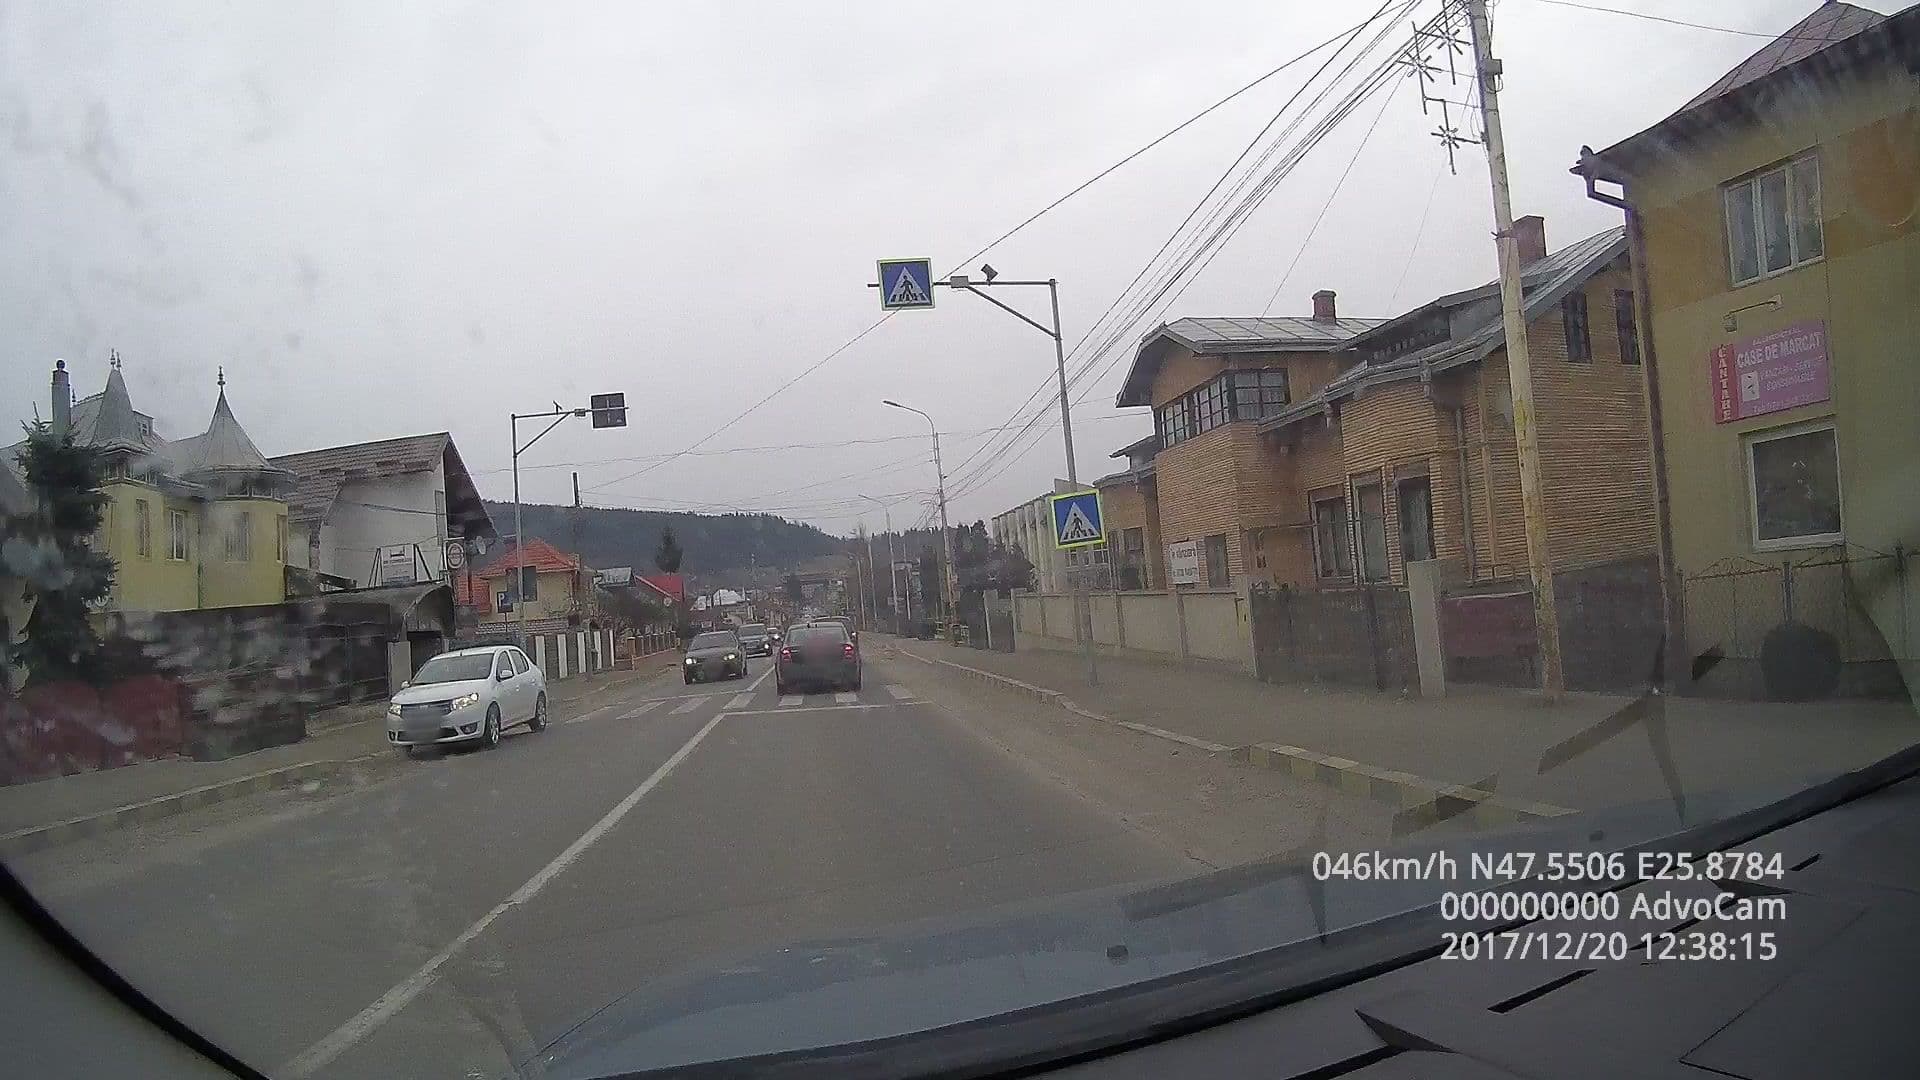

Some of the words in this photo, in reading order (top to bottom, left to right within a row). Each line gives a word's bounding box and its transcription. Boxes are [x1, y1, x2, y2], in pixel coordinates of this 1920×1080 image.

[1737, 350, 1763, 368] CASE
[1764, 344, 1779, 360] DE
[1781, 332, 1824, 356] MARCAT
